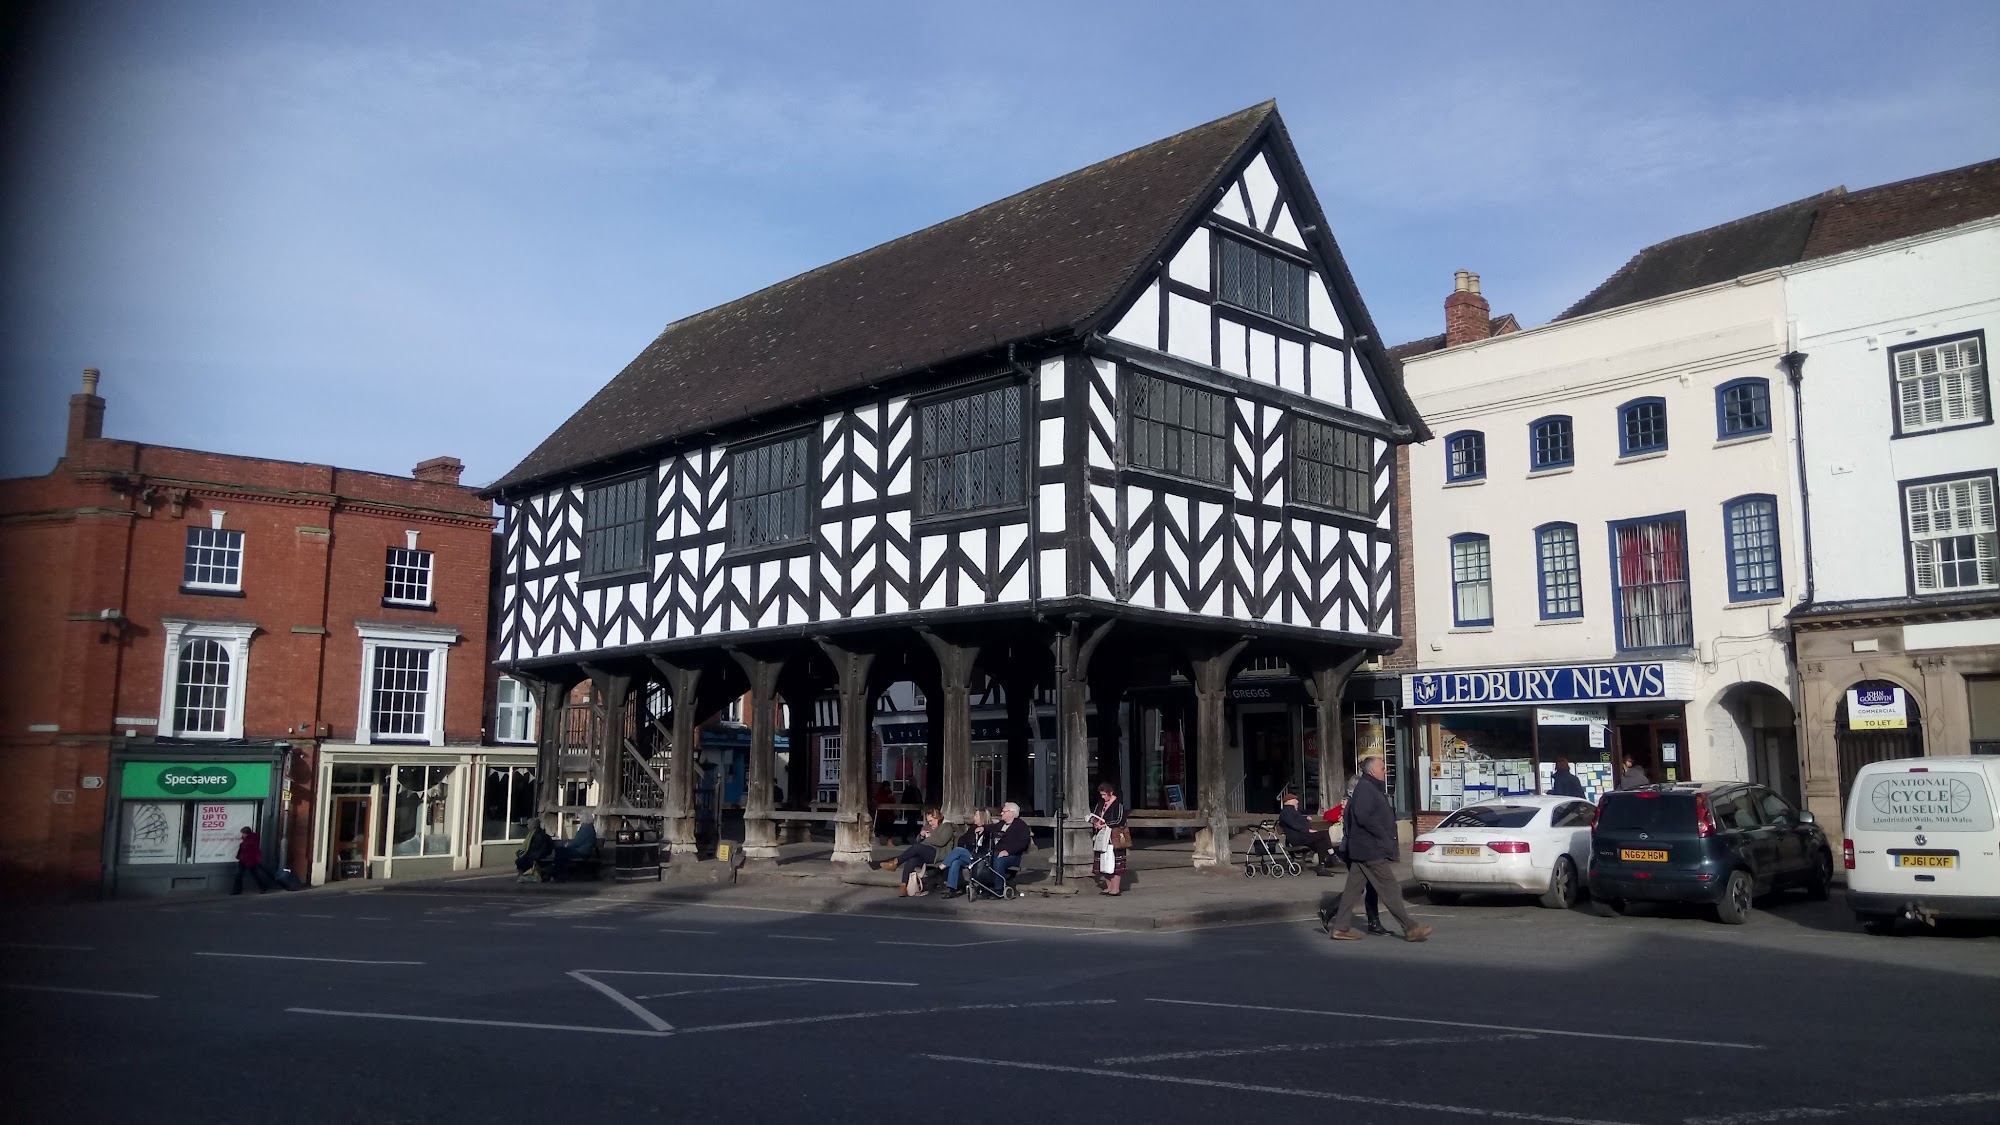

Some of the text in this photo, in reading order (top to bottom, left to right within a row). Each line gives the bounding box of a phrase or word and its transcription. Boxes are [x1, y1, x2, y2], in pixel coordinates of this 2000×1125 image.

[1440, 664, 1663, 703] LEDBURY NEWS
[1233, 688, 1270, 698] GREGGS
[1867, 690, 1884, 698] JOHN
[165, 773, 228, 787] Specsavers
[1891, 778, 1948, 787] NATIONAL
[1891, 790, 1949, 802] CYCLE
[1892, 805, 1948, 814] MUSEUM
[202, 820, 225, 828] £250
[1624, 850, 1646, 859] NG62
[1903, 856, 1949, 866] PJ61 CXF
